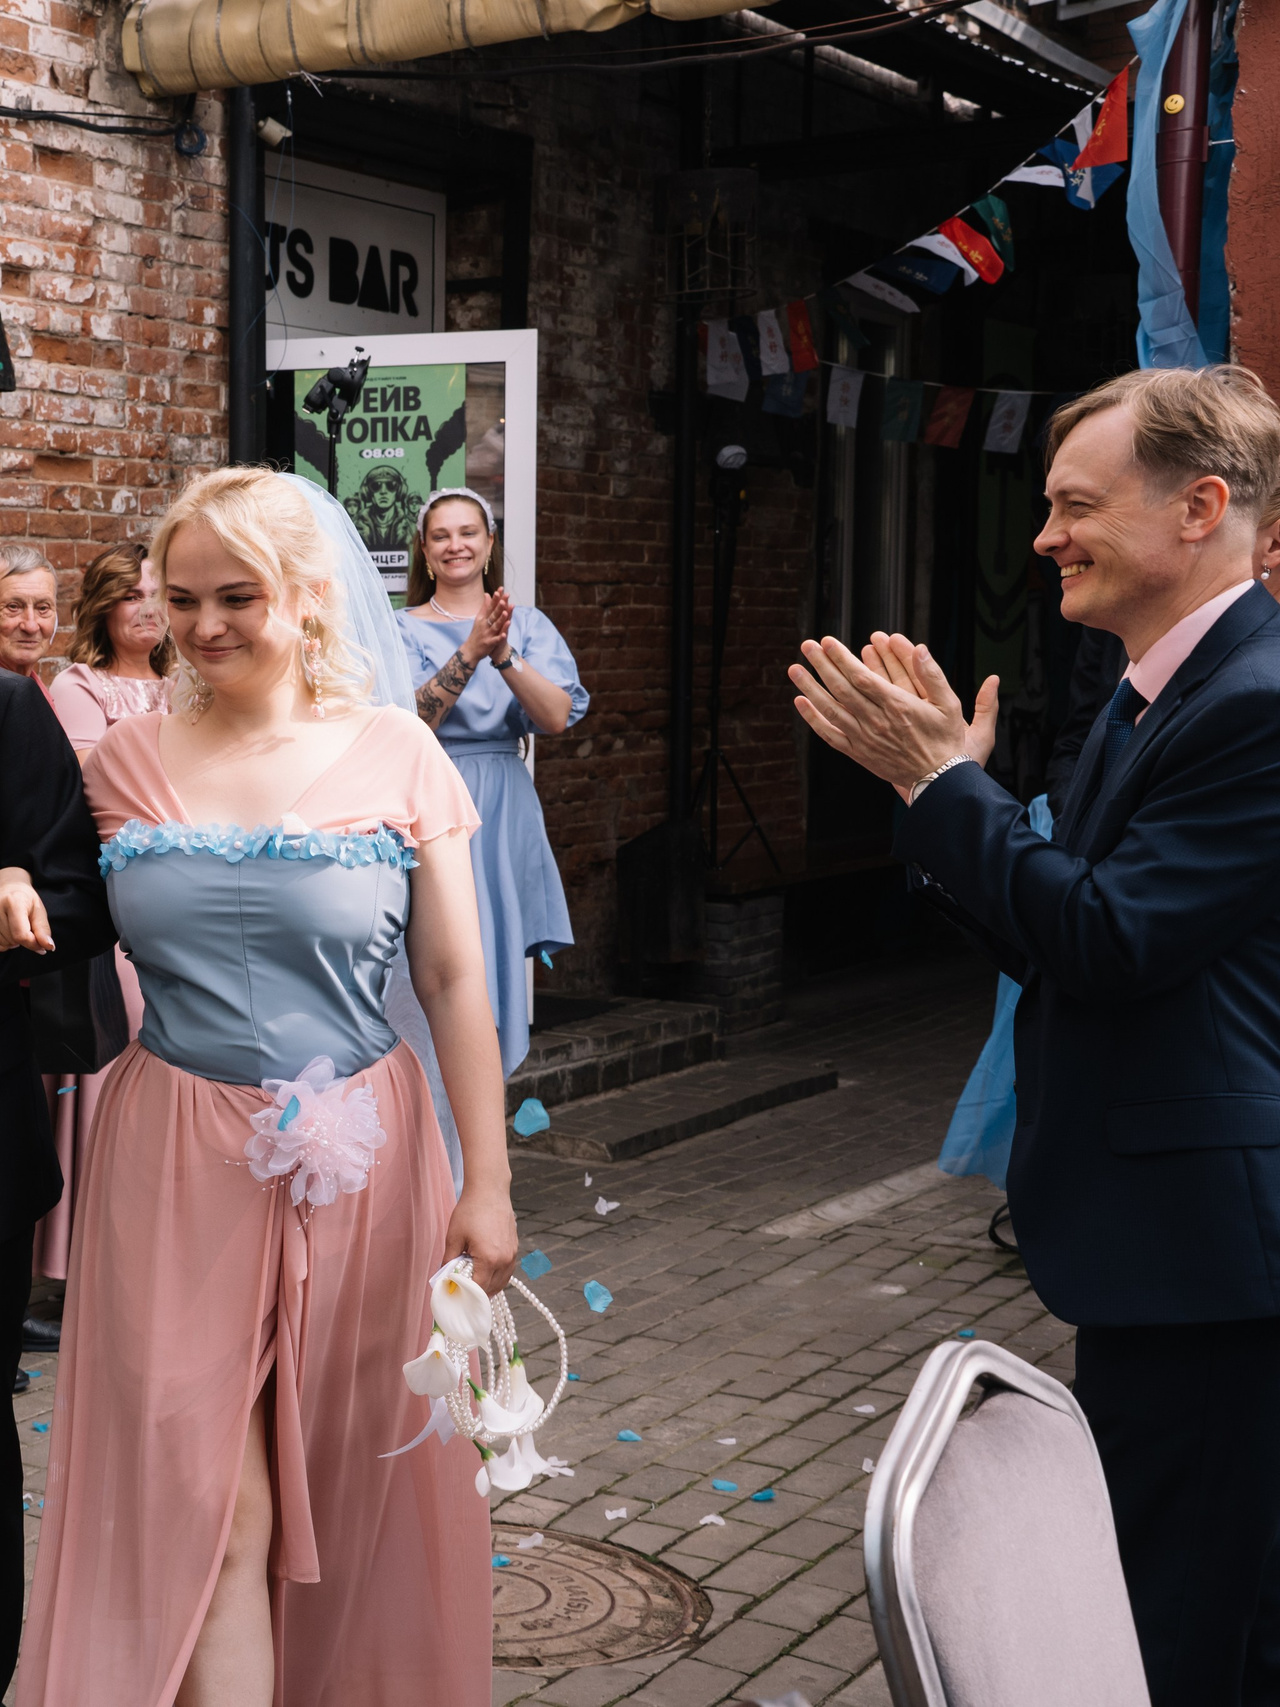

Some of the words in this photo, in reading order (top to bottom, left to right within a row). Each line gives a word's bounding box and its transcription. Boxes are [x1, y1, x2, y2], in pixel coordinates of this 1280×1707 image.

[329, 237, 418, 317] BAR
[346, 384, 422, 413] ЕЙВ
[361, 447, 404, 459] 08.08
[371, 554, 405, 565] НЦЕР
